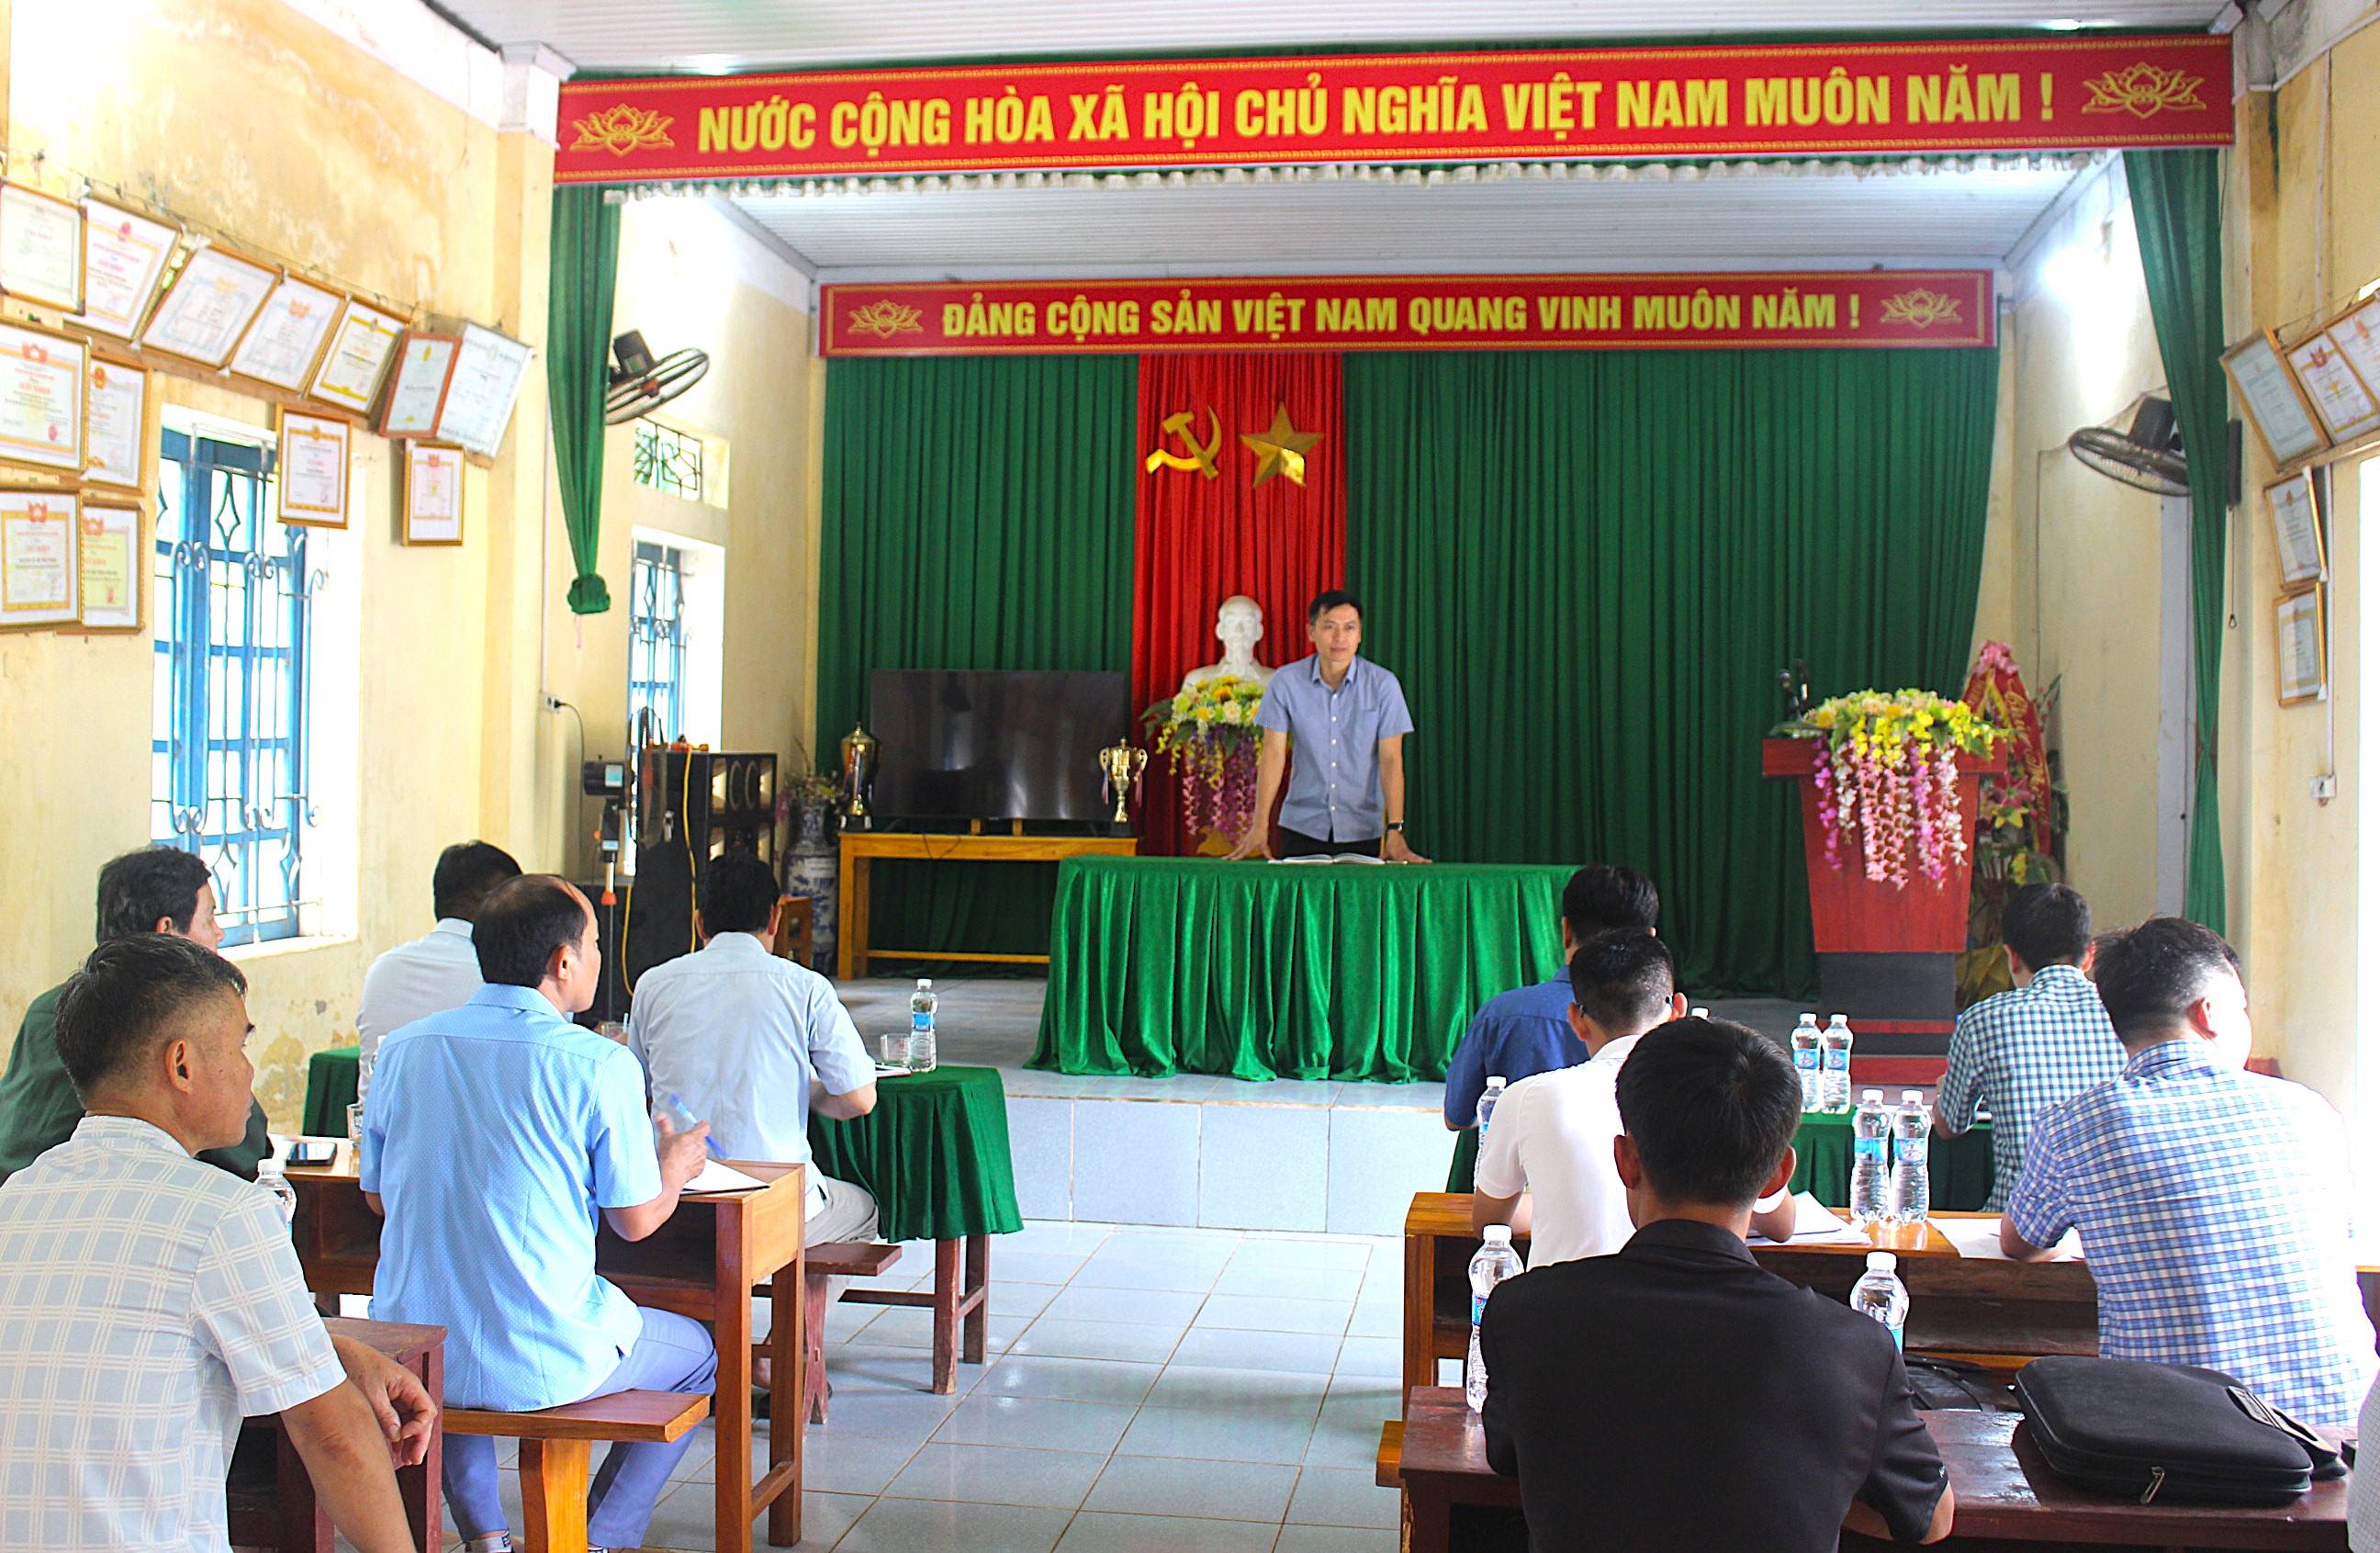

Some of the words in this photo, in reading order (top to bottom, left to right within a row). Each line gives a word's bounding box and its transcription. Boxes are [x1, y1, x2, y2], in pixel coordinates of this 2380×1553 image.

[700, 94, 815, 152] NƯỚC
[830, 91, 950, 156] CỘNG
[965, 85, 1053, 143] HÒA
[1070, 84, 1129, 140] XÃ
[1144, 81, 1219, 149] HỘI
[1235, 73, 1328, 136] CHỦ
[1343, 75, 1488, 133] NGHĨA
[1502, 73, 1602, 141] VIỆT
[1617, 79, 1728, 128] NAM
[1745, 66, 1891, 126] MUÔN
[1907, 64, 2021, 123] NĂM
[2040, 73, 2054, 120] !
[942, 291, 1036, 337] ĐẢNG
[1047, 294, 1139, 343] CỘNG
[1151, 288, 1222, 333] SẢN
[1233, 291, 1305, 340] VIỆT
[1316, 298, 1398, 332] NAM
[1409, 296, 1527, 334] QUANG
[1537, 295, 1622, 331] VINH
[1633, 288, 1741, 331] MUÔN
[1751, 287, 1836, 329] NĂM
[1849, 294, 1860, 327] !
